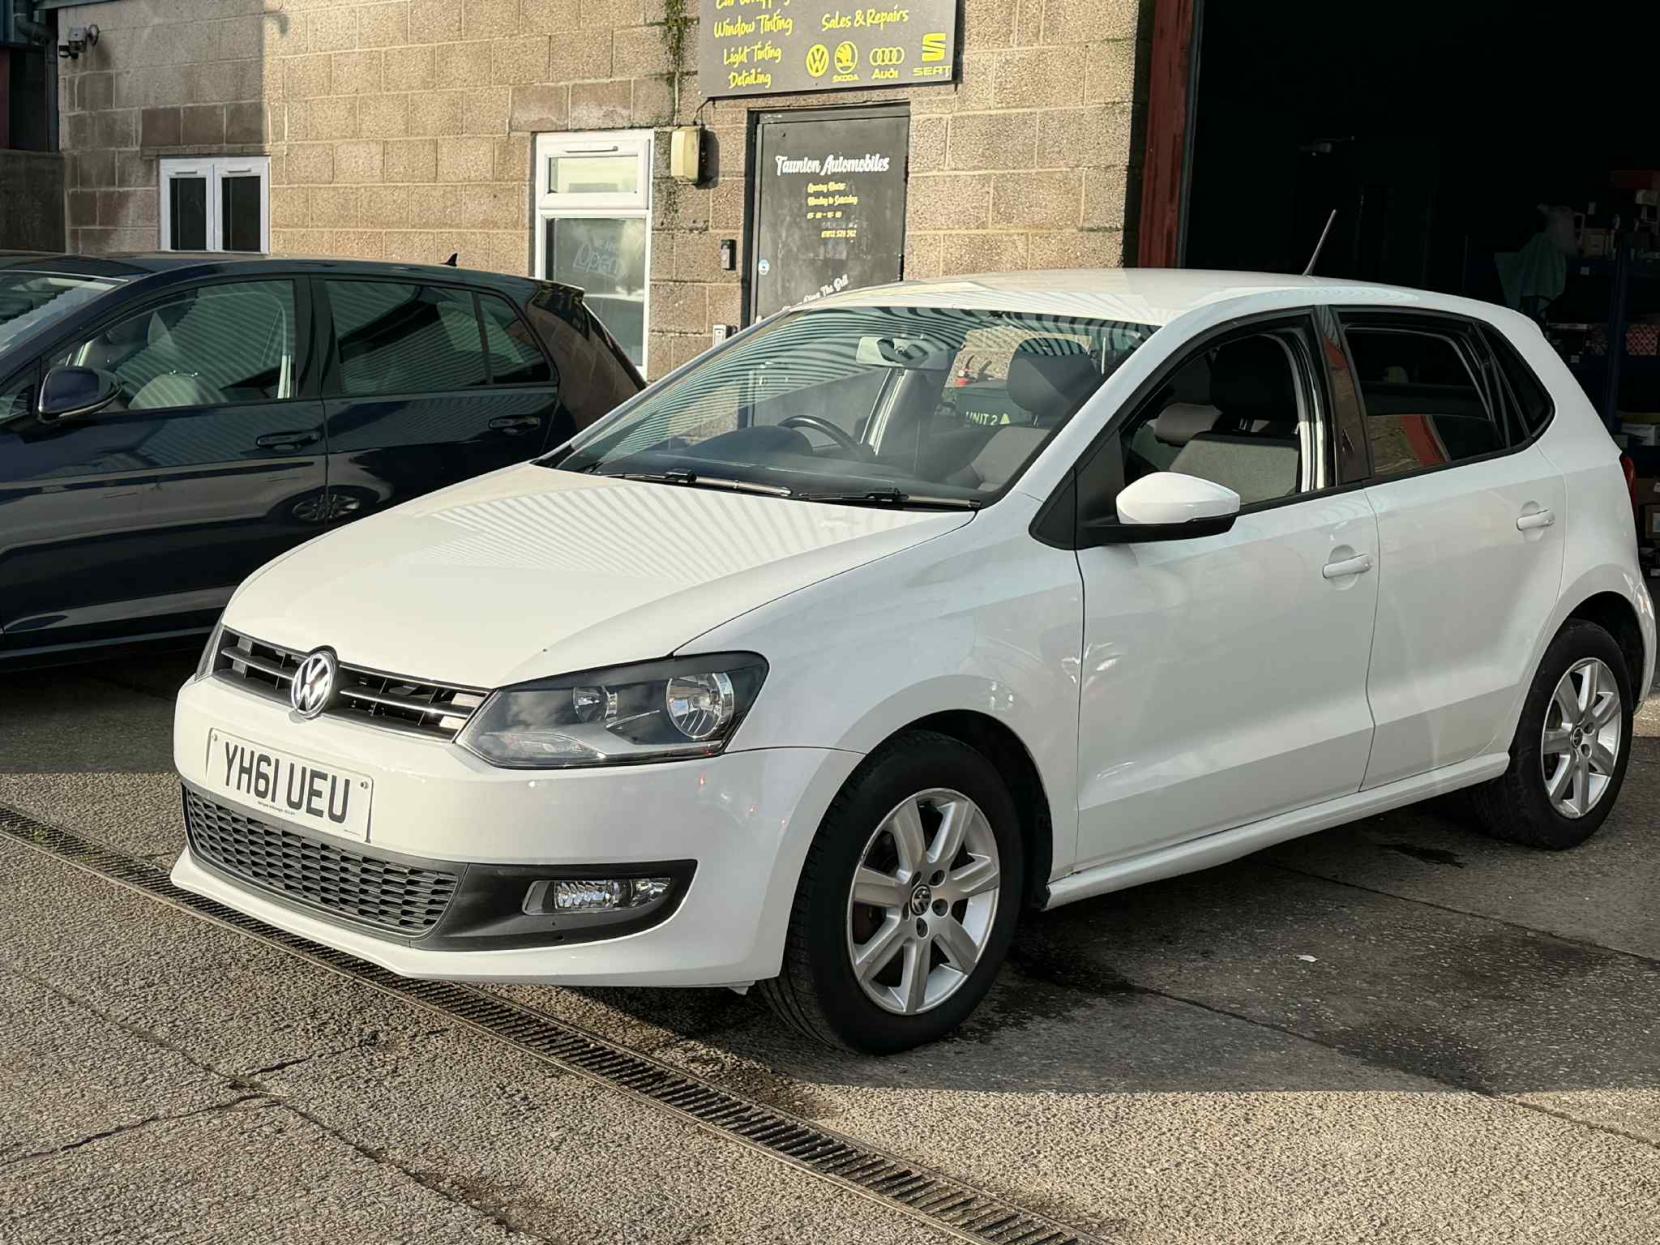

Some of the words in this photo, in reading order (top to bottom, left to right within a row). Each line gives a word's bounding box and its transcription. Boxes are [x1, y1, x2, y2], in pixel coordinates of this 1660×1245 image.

[714, 15, 755, 38] Window
[756, 8, 793, 36] Tinting
[821, 11, 851, 31] Sales
[854, 9, 866, 27] &
[867, 5, 909, 30] Repairs
[723, 45, 750, 68] Light
[751, 40, 782, 63] Tinting
[728, 68, 772, 89] Detailing
[871, 68, 899, 80] Audi
[912, 65, 952, 77] SEAT
[775, 155, 820, 176] Taunton
[820, 153, 890, 176] Automobiles
[990, 414, 998, 426] 2
[225, 741, 280, 803] YH61
[286, 762, 350, 824] UEU
